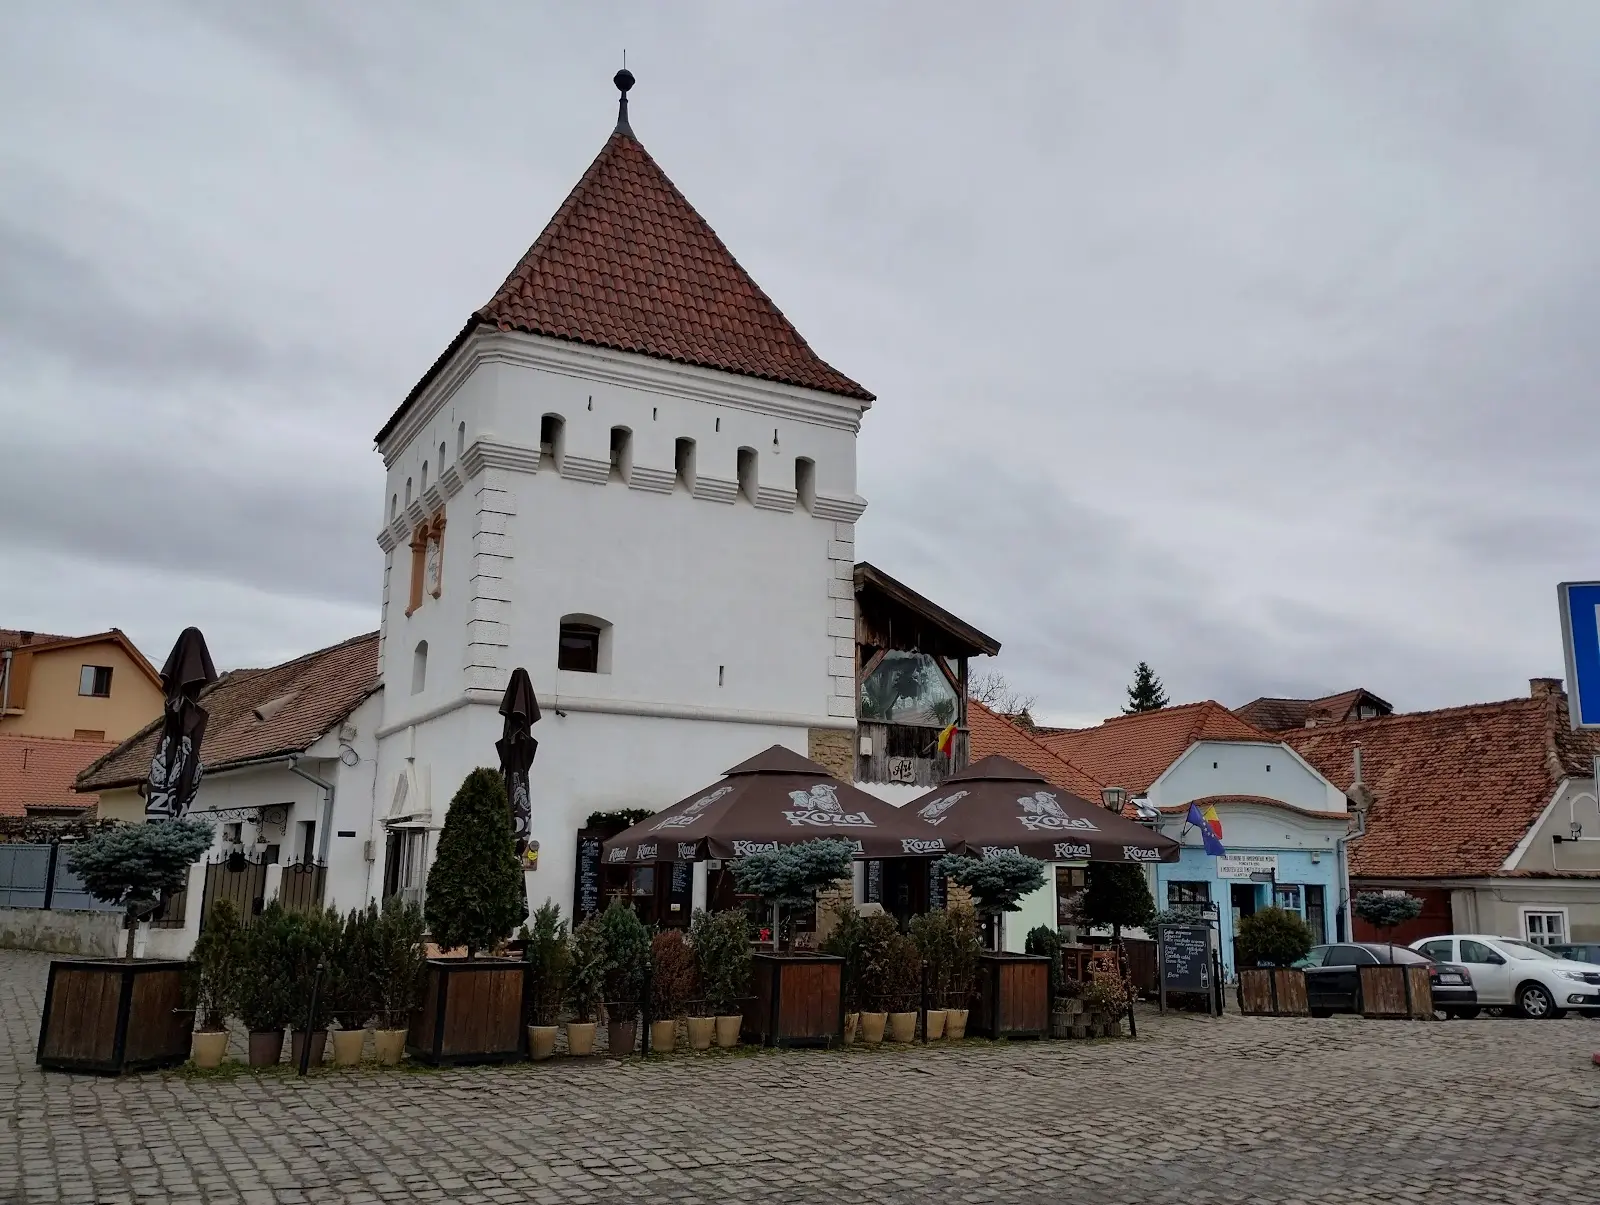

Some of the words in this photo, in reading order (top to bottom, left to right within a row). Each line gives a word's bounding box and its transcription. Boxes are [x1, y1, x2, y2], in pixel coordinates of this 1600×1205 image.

[893, 760, 911, 779] Art
[780, 809, 877, 827] Kozel
[1016, 814, 1102, 832] Kozel
[608, 846, 629, 862] Kozel
[636, 843, 658, 860] Kozel
[678, 842, 697, 860] Kozel
[731, 840, 779, 856] Kozel
[901, 838, 946, 854] Kozel
[1053, 842, 1092, 858] Kozel
[1123, 845, 1162, 861] Kozel
